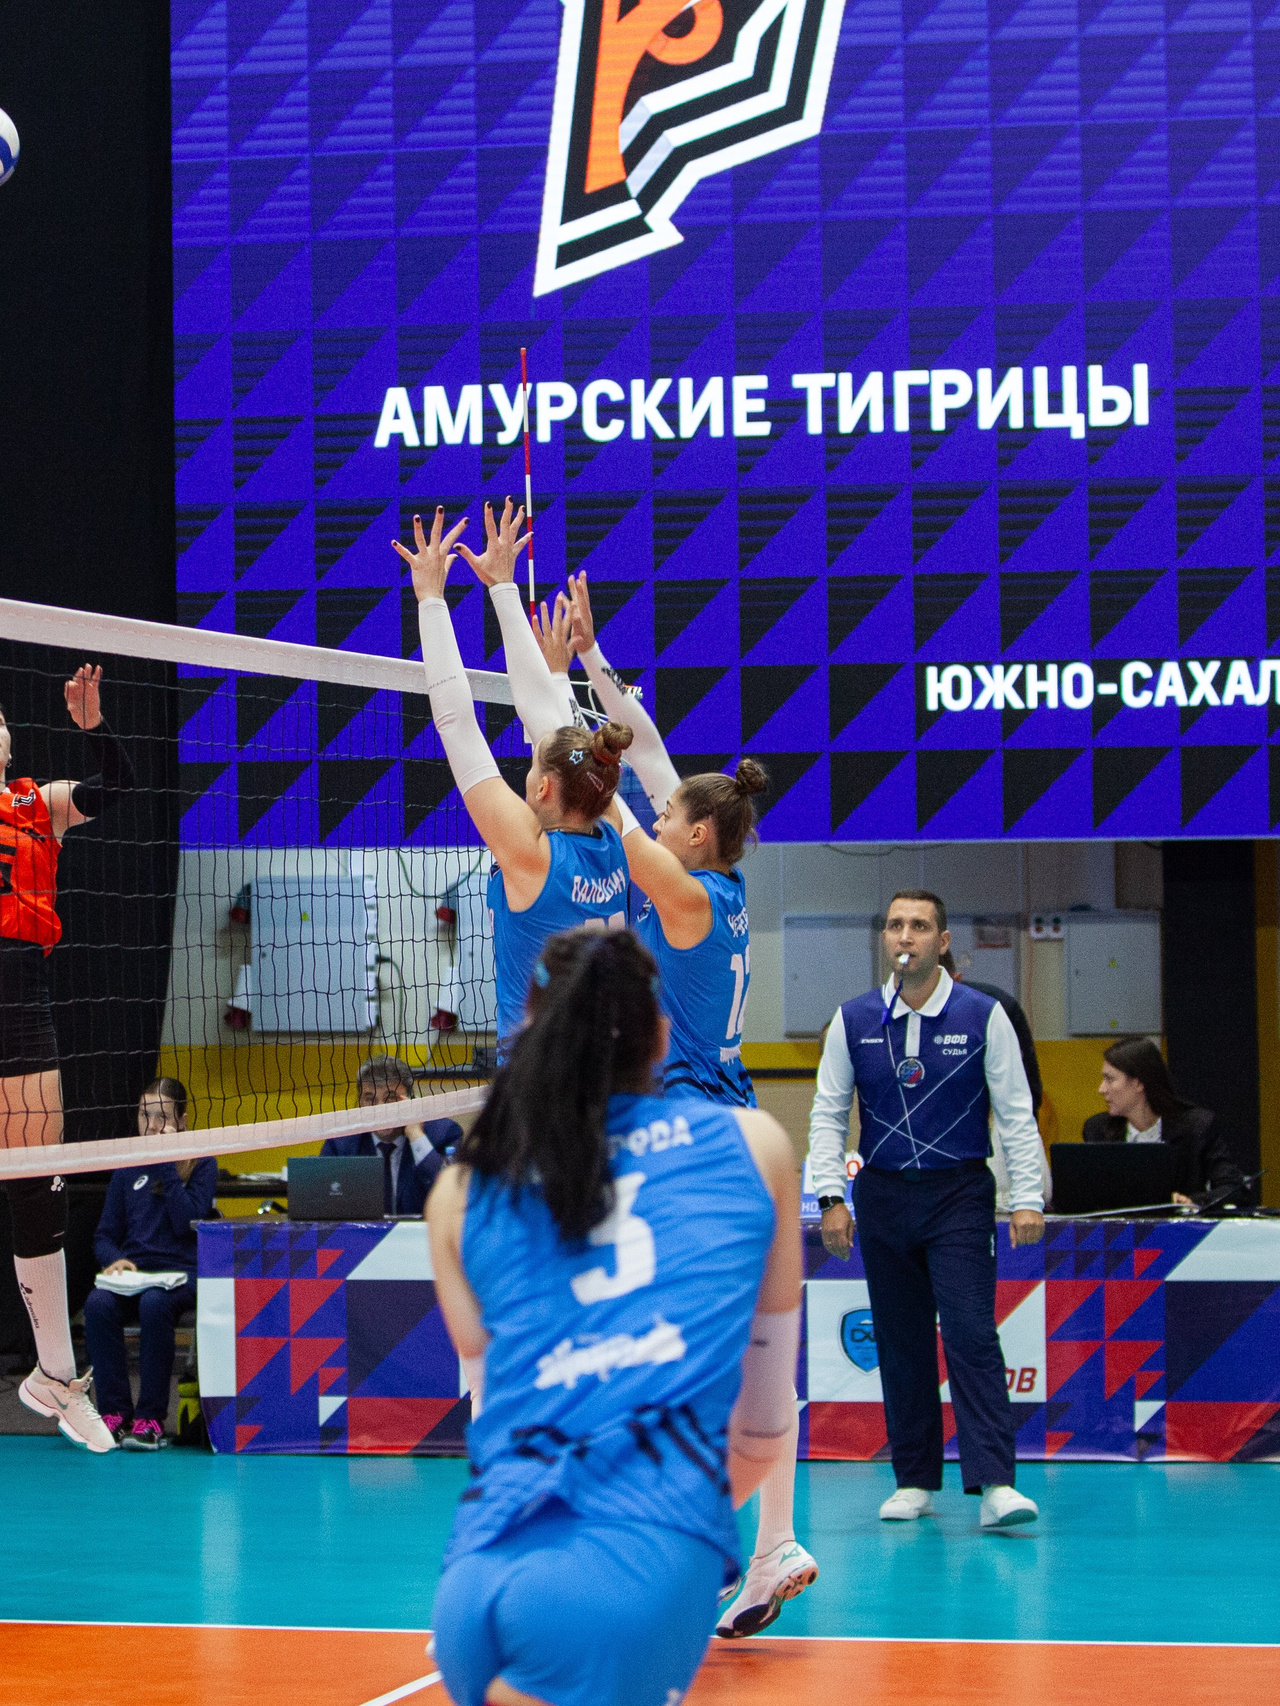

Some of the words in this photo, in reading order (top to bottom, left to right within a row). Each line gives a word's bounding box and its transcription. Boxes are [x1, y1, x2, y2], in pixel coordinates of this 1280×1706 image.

[373, 375, 773, 448] АМУРСКИЕ
[791, 363, 1149, 439] ТИГРИЦЫ
[942, 1048, 968, 1056] СУДЬЯ
